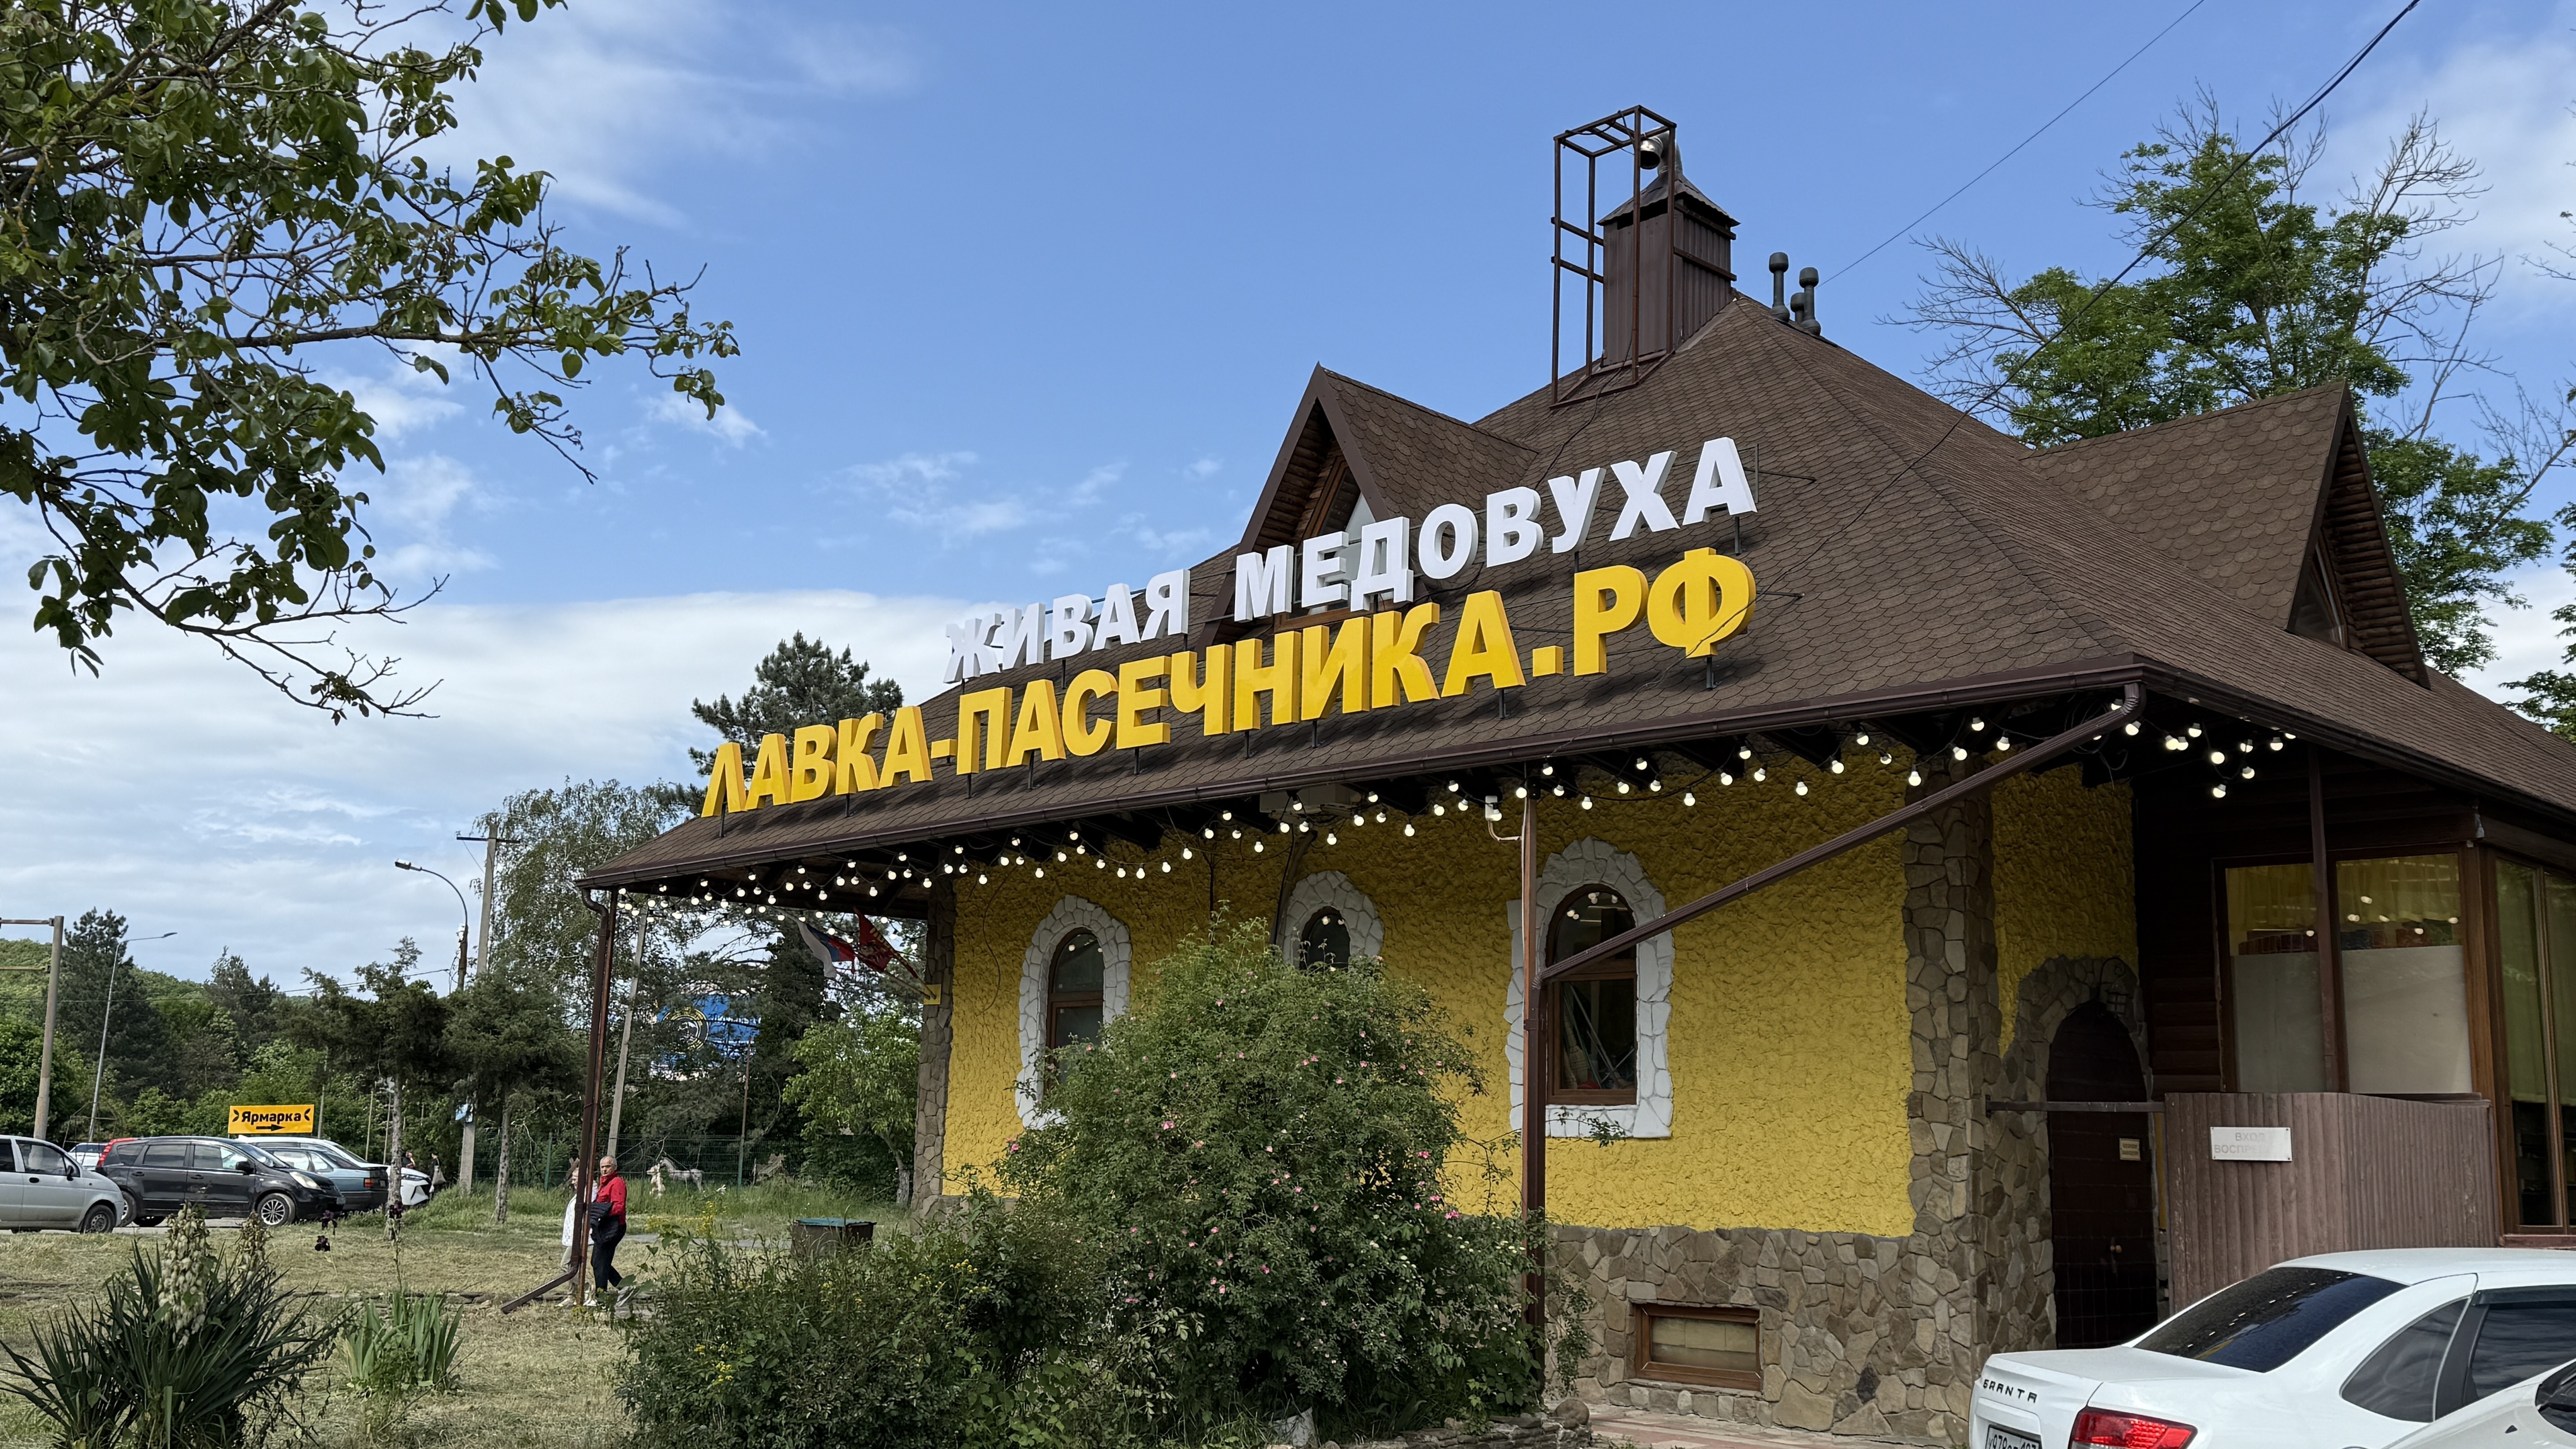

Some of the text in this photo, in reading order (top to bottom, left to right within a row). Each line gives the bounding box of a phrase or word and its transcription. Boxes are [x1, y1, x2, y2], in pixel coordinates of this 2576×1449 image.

[943, 437, 1757, 684] ЖИВАЯ МЕДОВУХА
[701, 547, 1757, 818] ЛАВКА-ПАСЕЧНИКА.РФ
[241, 1111, 301, 1125] Ярмарка
[1983, 1379, 2038, 1403] GRANTA
